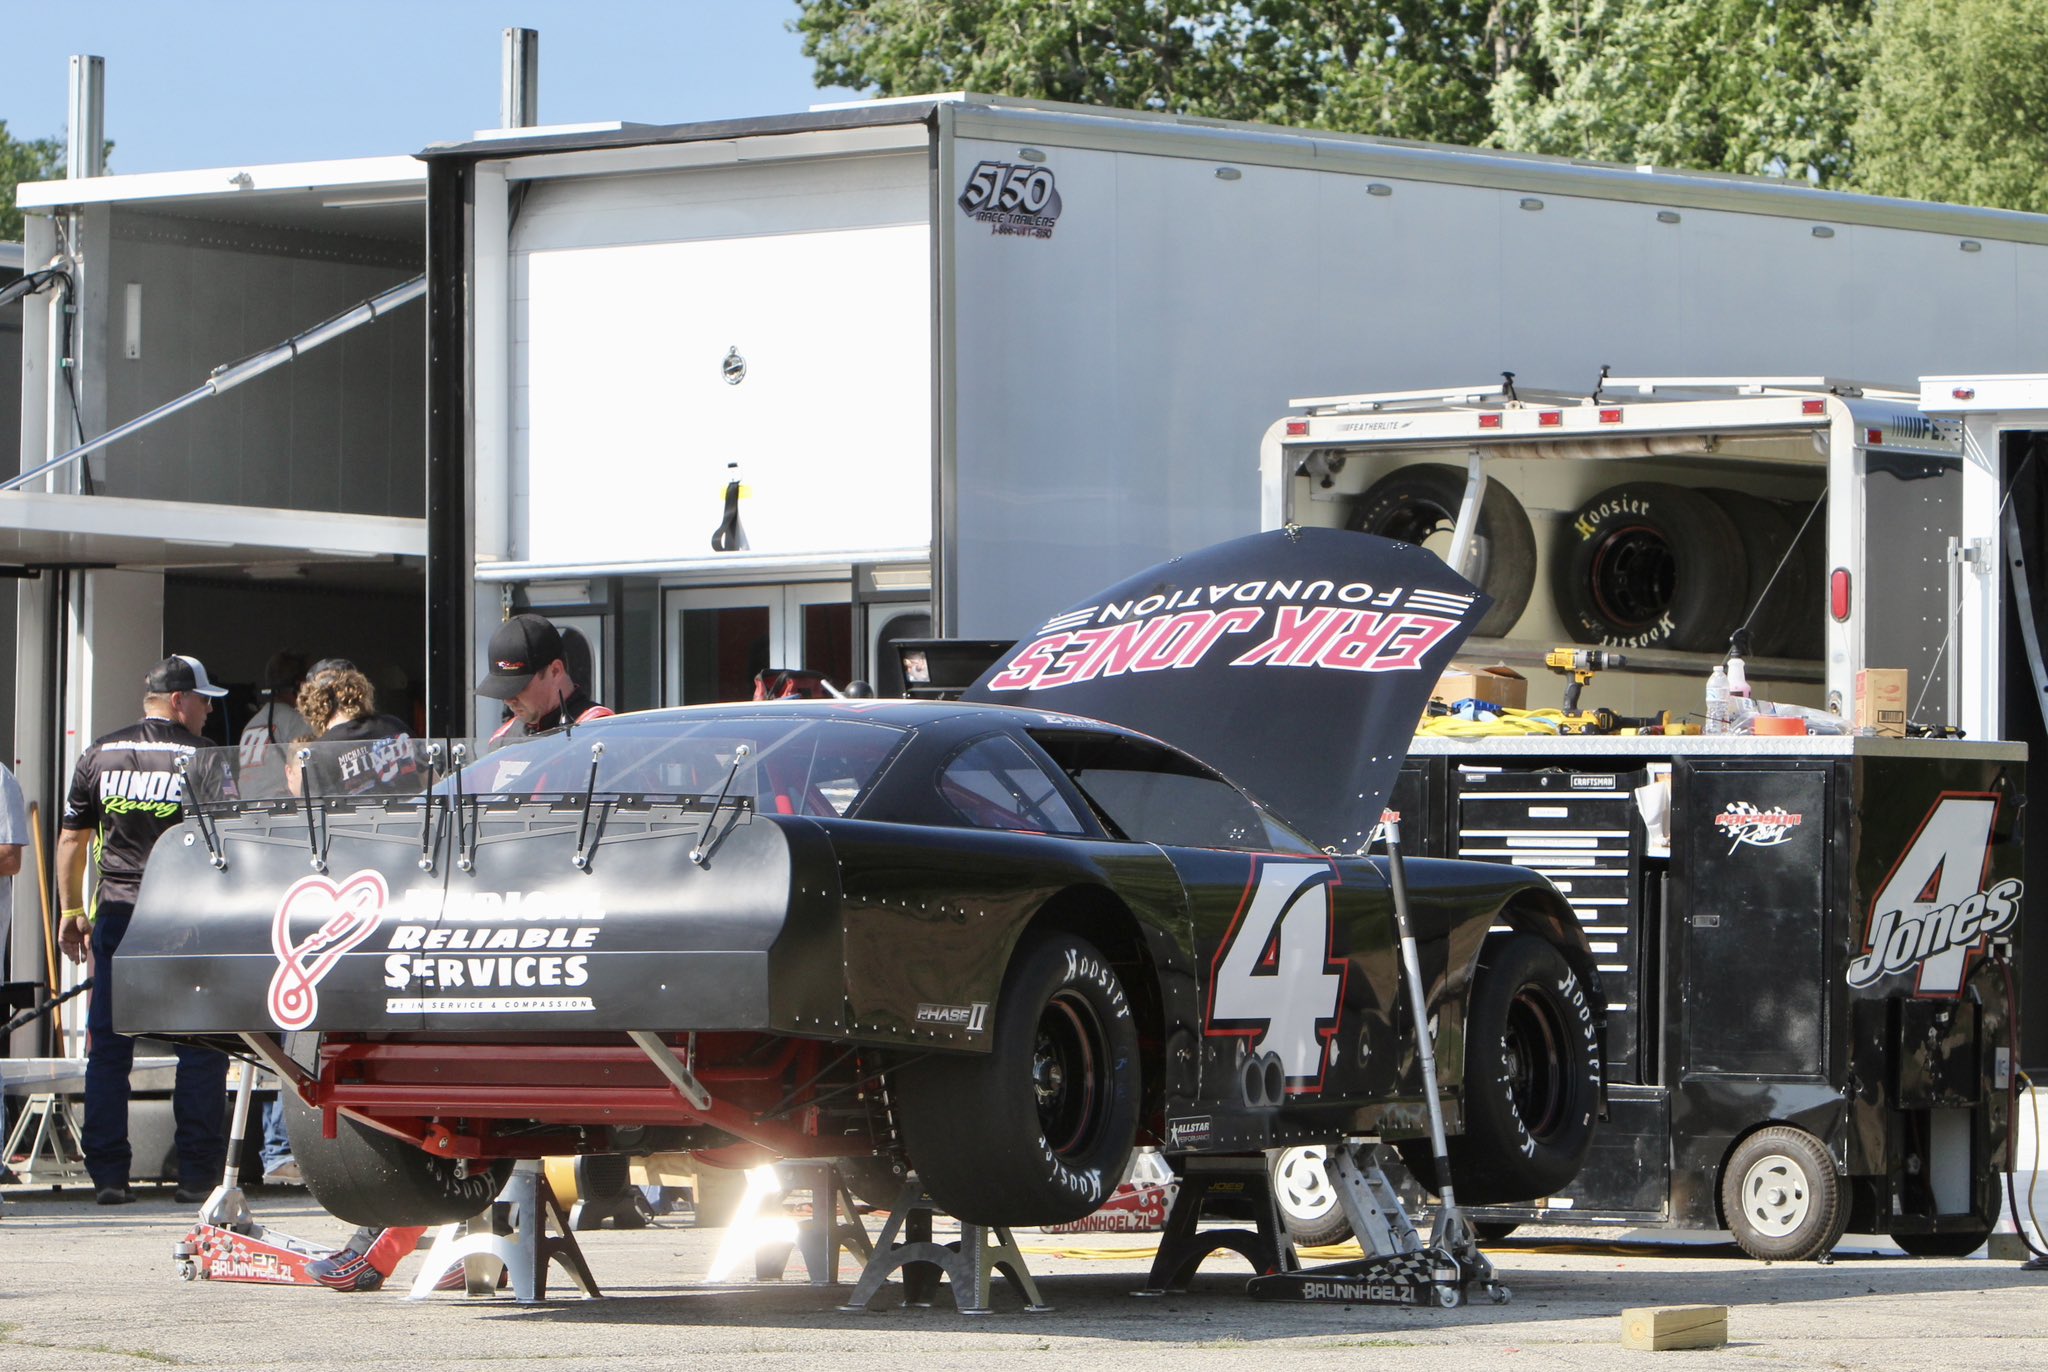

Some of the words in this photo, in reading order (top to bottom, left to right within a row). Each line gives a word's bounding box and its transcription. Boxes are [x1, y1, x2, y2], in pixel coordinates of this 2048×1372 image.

[961, 162, 1054, 214] 5150
[977, 211, 1005, 223] RACE
[1008, 213, 1055, 227] TRAILERS
[1347, 421, 1399, 432] FEATHERLITE
[1574, 493, 1649, 541] Hoosier
[1097, 579, 1403, 625] FOUNDATION
[988, 606, 1266, 691] JONES
[1230, 606, 1462, 673] ERIK
[338, 746, 369, 767] MICHAEL
[1573, 777, 1614, 787] CRAFTSMAN
[102, 795, 180, 818] Racing
[1863, 793, 1999, 996] 4
[387, 926, 600, 950] RELIABLE
[1848, 879, 2023, 987] Jones
[384, 954, 589, 989] SERVICES
[1063, 949, 1130, 1018] Hoosier
[1207, 856, 1347, 1090] 4
[504, 1001, 588, 1009] COMPASSION
[917, 1008, 971, 1022] PHASE
[1558, 966, 1600, 1087] Hoosier
[1178, 1122, 1210, 1134] ALLSTAR
[1302, 1282, 1419, 1303] BRUNNHOELZL
